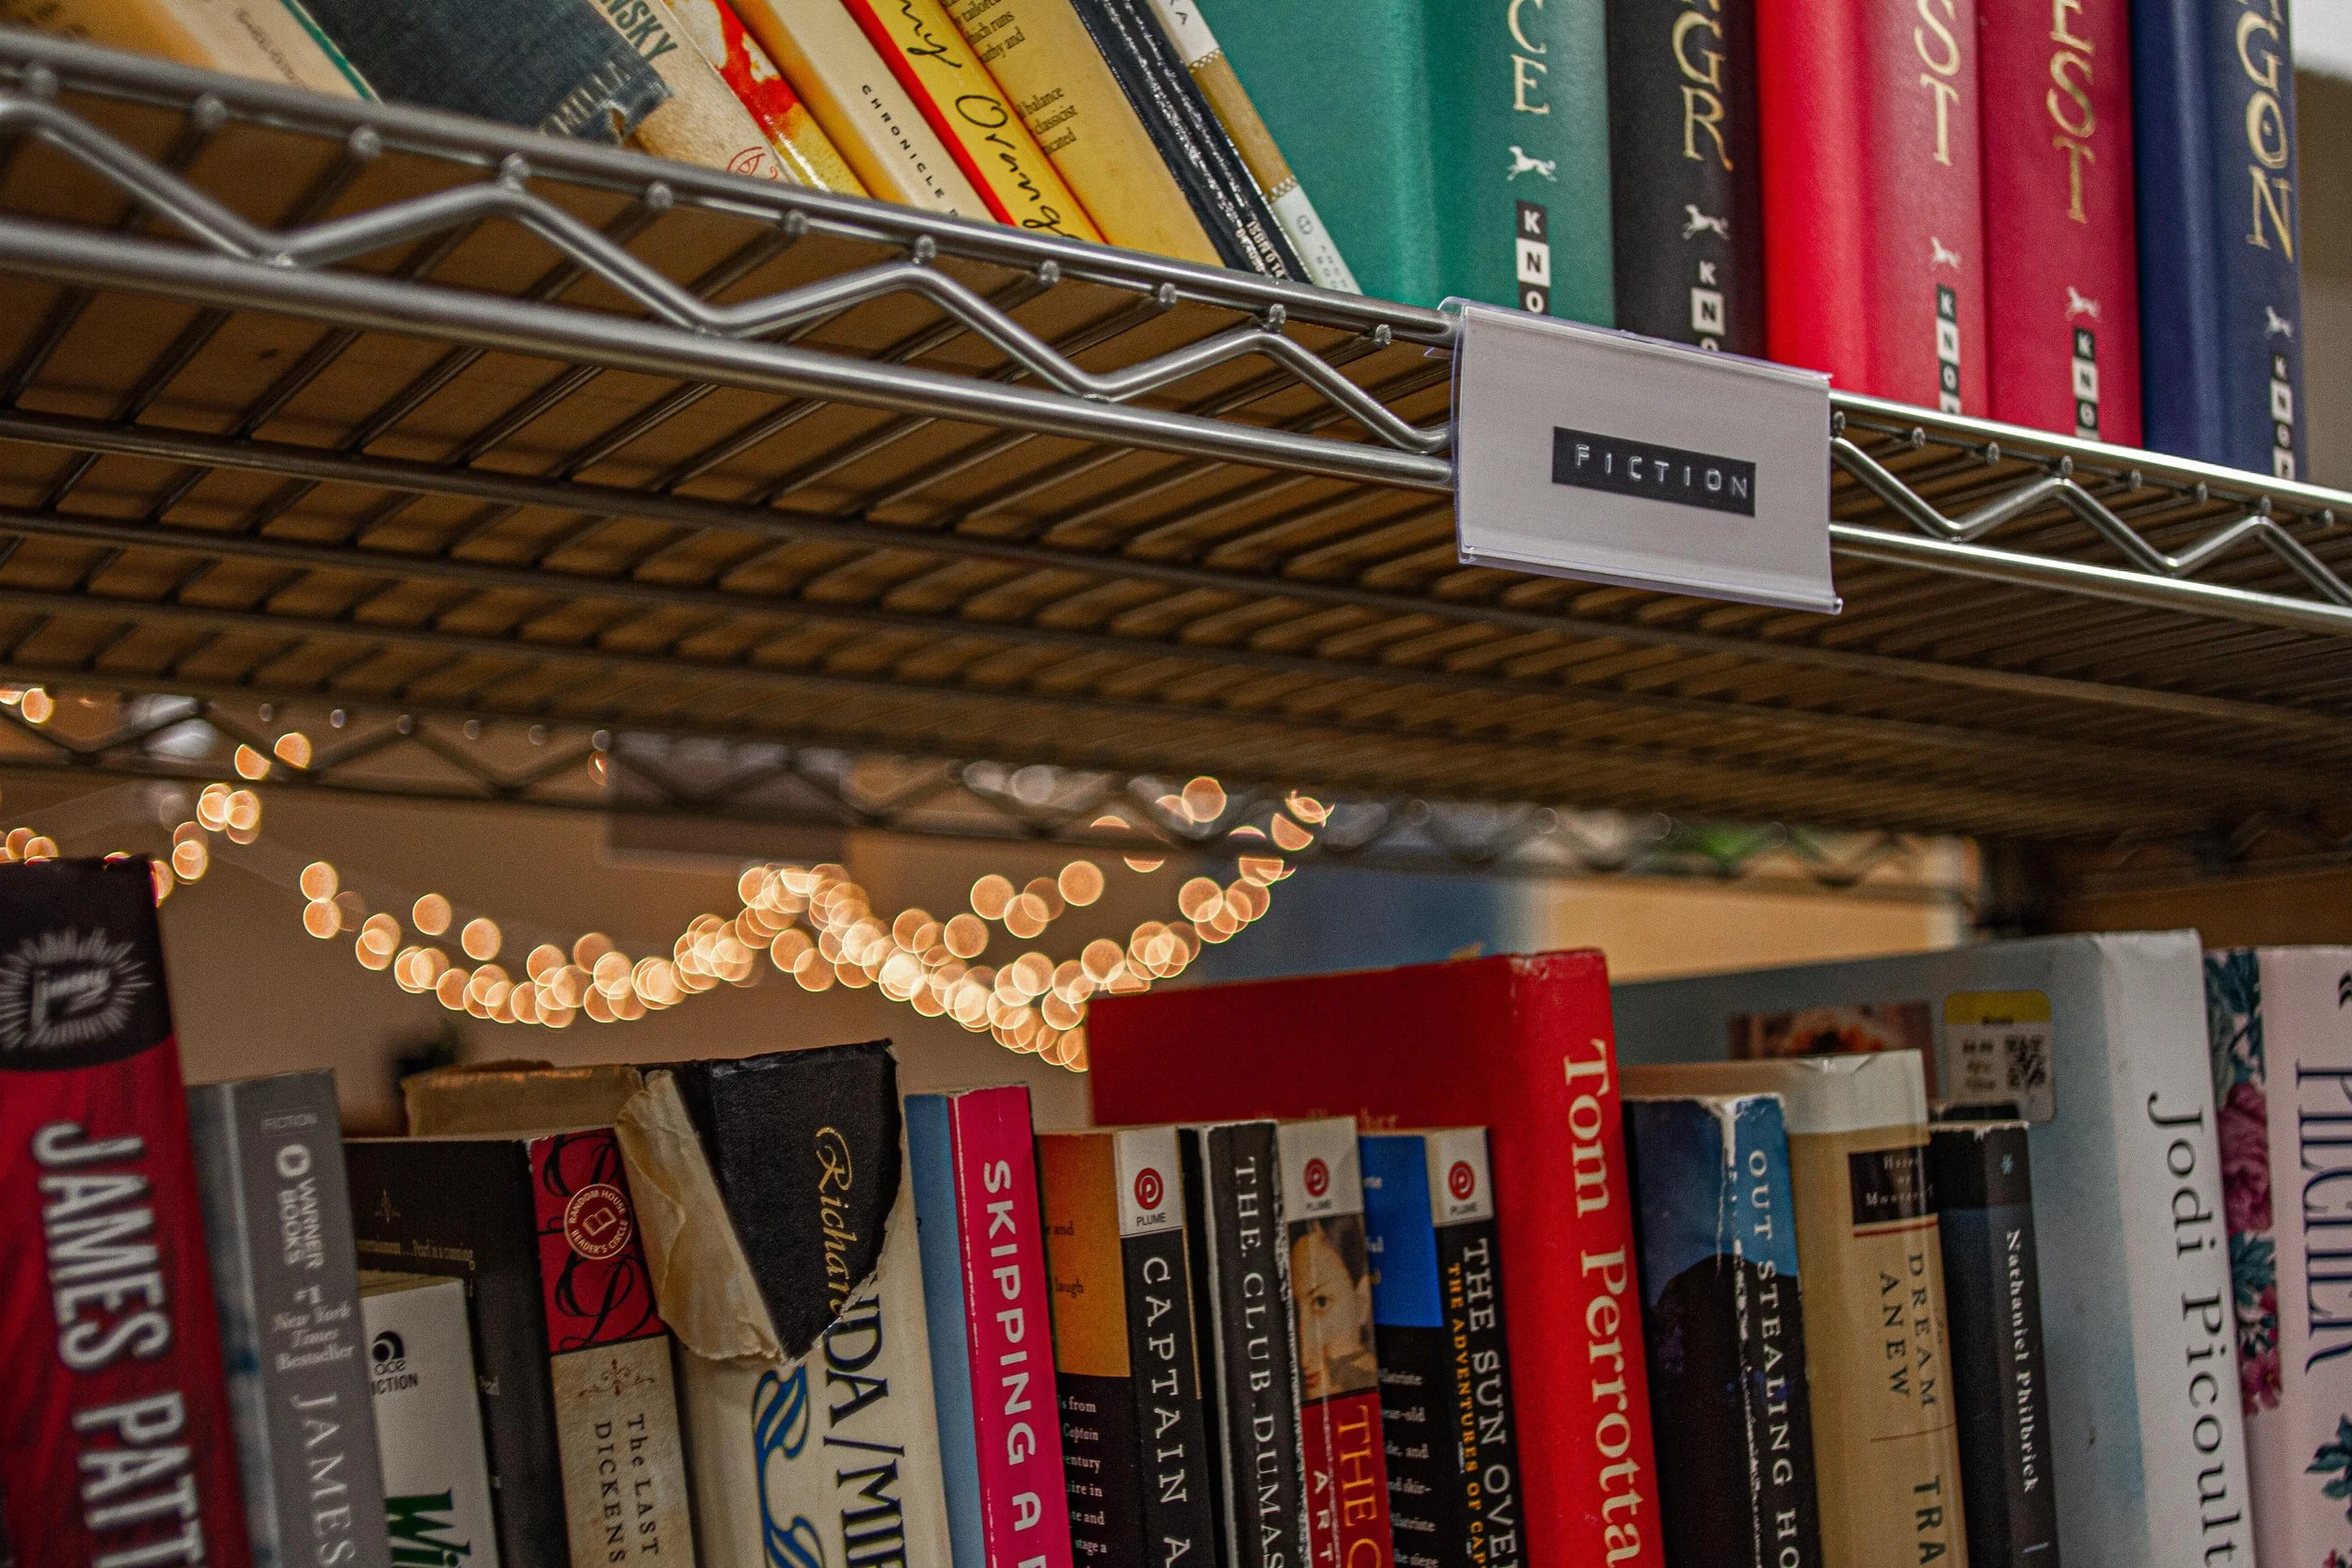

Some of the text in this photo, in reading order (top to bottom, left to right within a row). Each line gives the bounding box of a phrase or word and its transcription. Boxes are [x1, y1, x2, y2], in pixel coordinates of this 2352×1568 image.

[1507, 0, 1550, 115] CE
[1672, 0, 1734, 171] GR
[861, 84, 945, 199] CHRONICLE
[955, 95, 1083, 239] Orang
[2235, 0, 2294, 263] GON
[1573, 443, 1749, 498] FICTION
[278, 1189, 304, 1265] BOOKS
[297, 1177, 326, 1270] WARNER
[568, 1189, 627, 1224] RANDOM HOUSE
[608, 1219, 629, 1249] CIRCLE
[1136, 1212, 1168, 1227] PLUME
[1233, 1156, 1261, 1253] THE
[1748, 1148, 1773, 1241] OUT
[1242, 1272, 1271, 1392] CLUB
[1463, 1237, 1497, 1333] THE
[1564, 1037, 1643, 1568] Tom Perrotta
[1879, 1272, 1912, 1398] ANEW
[1908, 1253, 1937, 1408] DREAM
[2147, 1091, 2242, 1568] Jodi Picoult
[32, 1119, 209, 1568] JAMES PATT
[371, 1373, 419, 1396] ICTION
[983, 1160, 1037, 1466] SKIPPING
[1012, 1492, 1042, 1532] A
[1142, 1257, 1188, 1503] CAPTAIN
[1471, 1349, 1507, 1446] SUN
[1757, 1259, 1793, 1487] STEALING
[2006, 1228, 2040, 1494] Nathaniel Philbrick
[1062, 1422, 1099, 1443] Captain
[1069, 1396, 1097, 1413] from
[1448, 1262, 1487, 1568] THE ADVENTURES OF CAP
[288, 1391, 356, 1568] JAMES
[593, 1420, 628, 1565] DICKENS
[627, 1413, 660, 1558] The LAST
[1063, 1456, 1102, 1474] entury
[1084, 1511, 1105, 1526] and
[1089, 1483, 1104, 1497] in
[1337, 1404, 1378, 1528] THE
[1913, 1475, 1946, 1565] TRA
[1100, 1543, 1107, 1553] a
